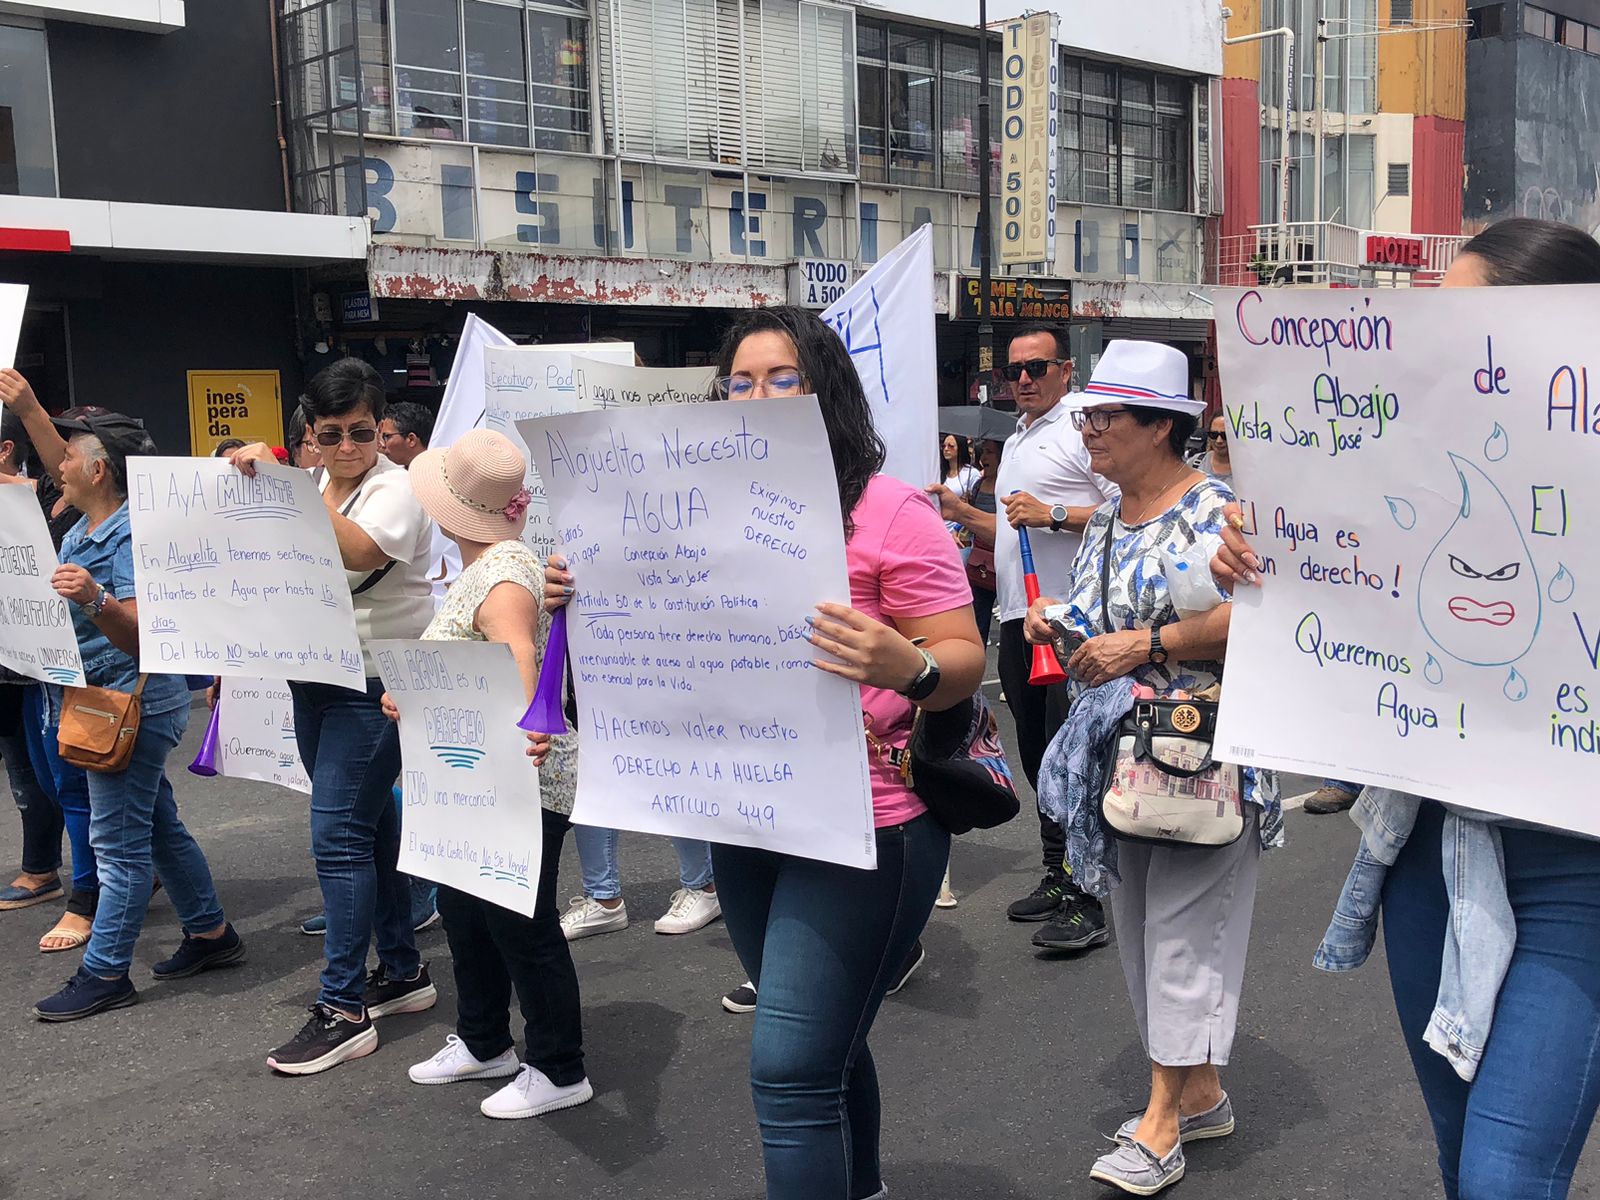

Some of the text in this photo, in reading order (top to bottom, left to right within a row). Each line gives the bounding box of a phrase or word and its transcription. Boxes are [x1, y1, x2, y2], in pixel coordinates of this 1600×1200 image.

[1005, 23, 1023, 139] TODO
[1049, 38, 1057, 137] TODO
[1005, 171, 1022, 241] 500
[1048, 169, 1056, 237] 500
[1367, 236, 1429, 266] HOTEL
[805, 261, 847, 283] TODO
[807, 284, 845, 303] A 500
[1237, 290, 1393, 367] Concepción
[1474, 335, 1510, 394] de
[206, 388, 245, 405] ines
[577, 369, 588, 399] El
[593, 385, 616, 410] agua
[621, 388, 641, 403] nos
[208, 406, 248, 423] pera
[1314, 373, 1399, 439] Abajo
[209, 421, 231, 437] da
[1226, 402, 1362, 456] Vista San José
[137, 471, 295, 516] El AyA MIENTE
[750, 481, 806, 515] Exigimos
[622, 487, 709, 536] AGUA
[1531, 485, 1569, 536] El
[744, 525, 807, 560] DERECHO
[1275, 506, 1319, 551] Agua
[1336, 529, 1360, 548] es
[140, 537, 333, 571] En Alajuelita tenemos sectores con
[675, 543, 706, 562] Abajo
[202, 582, 216, 597] de
[231, 579, 257, 601] Agua
[263, 586, 280, 600] por
[285, 581, 314, 595] hasta
[321, 583, 333, 600] 15
[637, 569, 662, 586] Vista
[667, 569, 684, 584] San
[616, 594, 628, 609] 50
[634, 599, 643, 609] de
[585, 620, 614, 640] Toda
[618, 624, 655, 646] persona
[686, 628, 722, 643] derecho
[1295, 611, 1411, 675] Queremos
[37, 646, 82, 670] UNIVERSAL
[161, 641, 361, 667] Del tubo NO sale una gota de AGUA
[642, 655, 650, 667] de
[700, 660, 724, 674] agua
[781, 659, 810, 670] como
[378, 649, 488, 692] EL AGUA es un
[232, 690, 259, 699] como
[1378, 682, 1438, 737] Agua
[1556, 683, 1589, 714] es
[264, 710, 273, 726] al
[423, 706, 486, 746] DERECHO
[739, 717, 799, 740] nuestro
[612, 754, 793, 785] DERECHO A LA HUELGA
[434, 791, 448, 806] una
[737, 801, 776, 831] 449
[409, 831, 417, 851] El
[420, 842, 435, 861] agua
[482, 847, 491, 867] No
